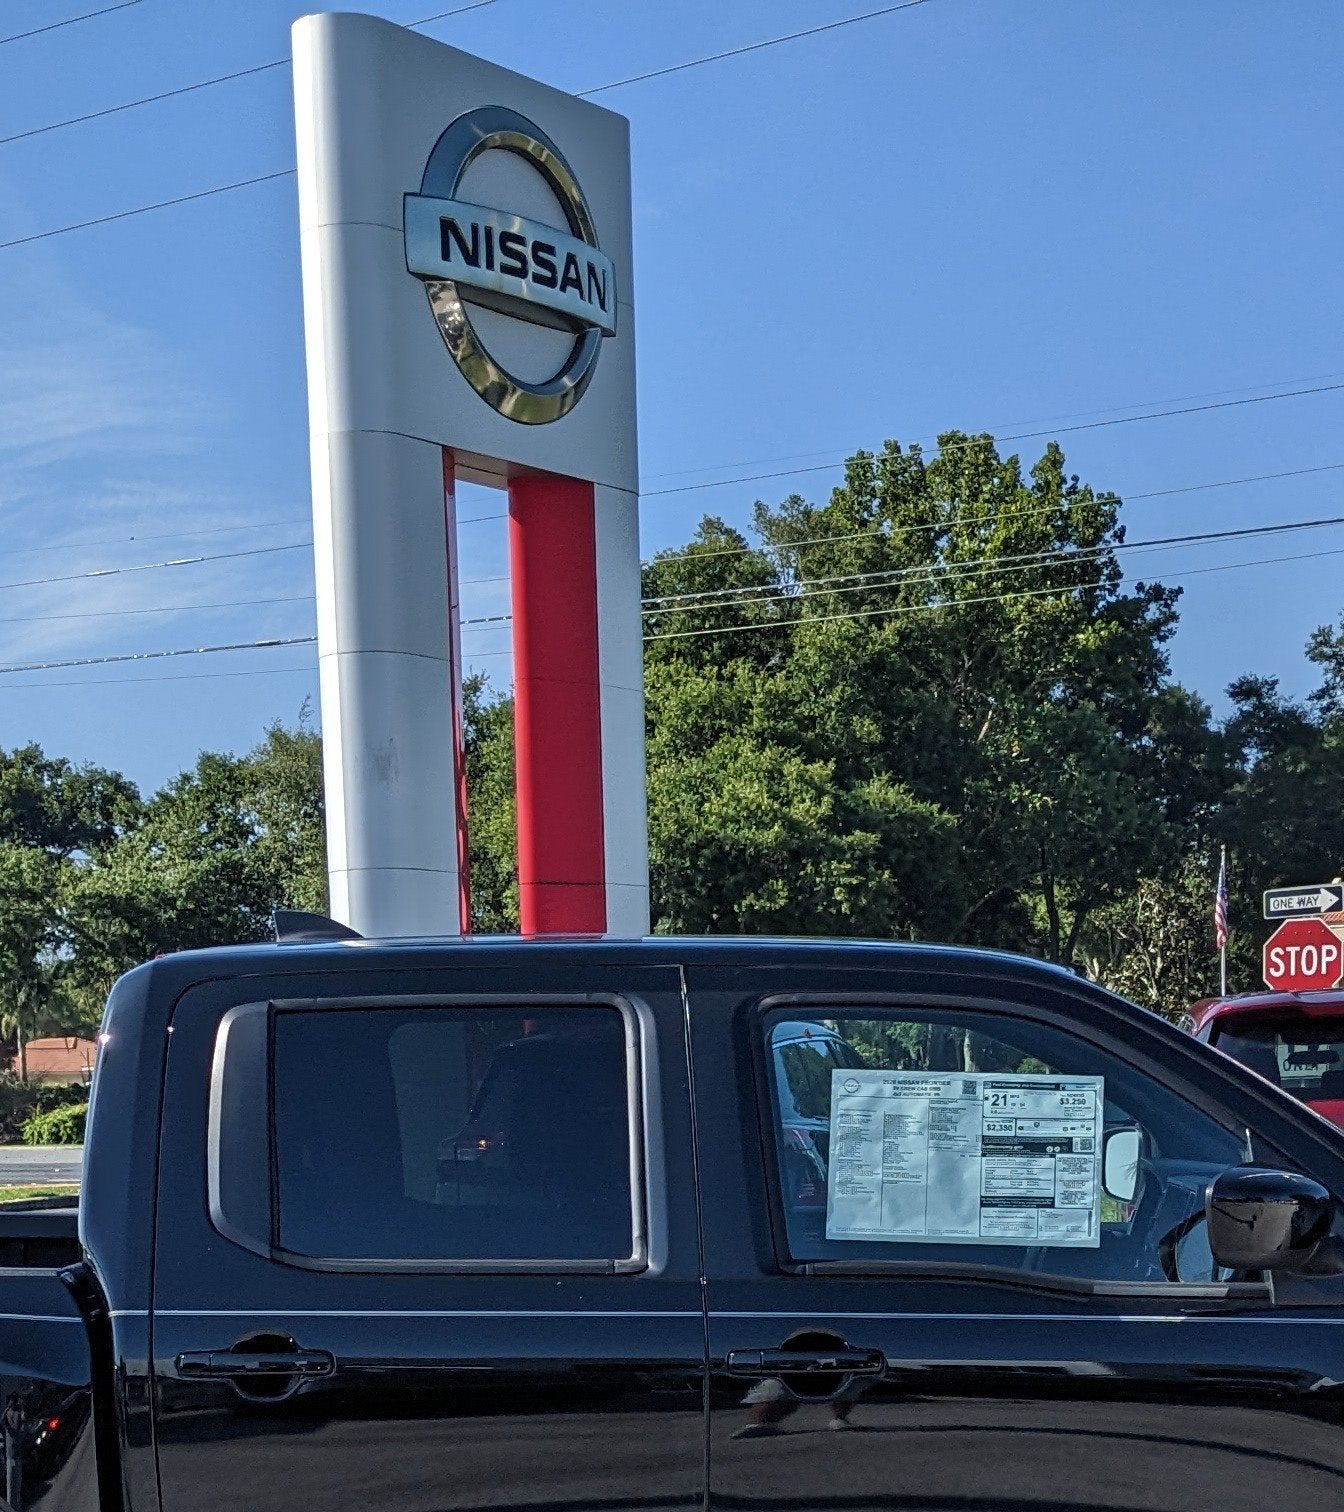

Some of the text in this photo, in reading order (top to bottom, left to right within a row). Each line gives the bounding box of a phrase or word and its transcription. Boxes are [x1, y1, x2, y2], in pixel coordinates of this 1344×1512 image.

[439, 215, 610, 313] NISSAN
[1272, 895, 1319, 909] ONE WAY
[1269, 944, 1338, 978] STOP
[990, 1093, 1007, 1107] 21
